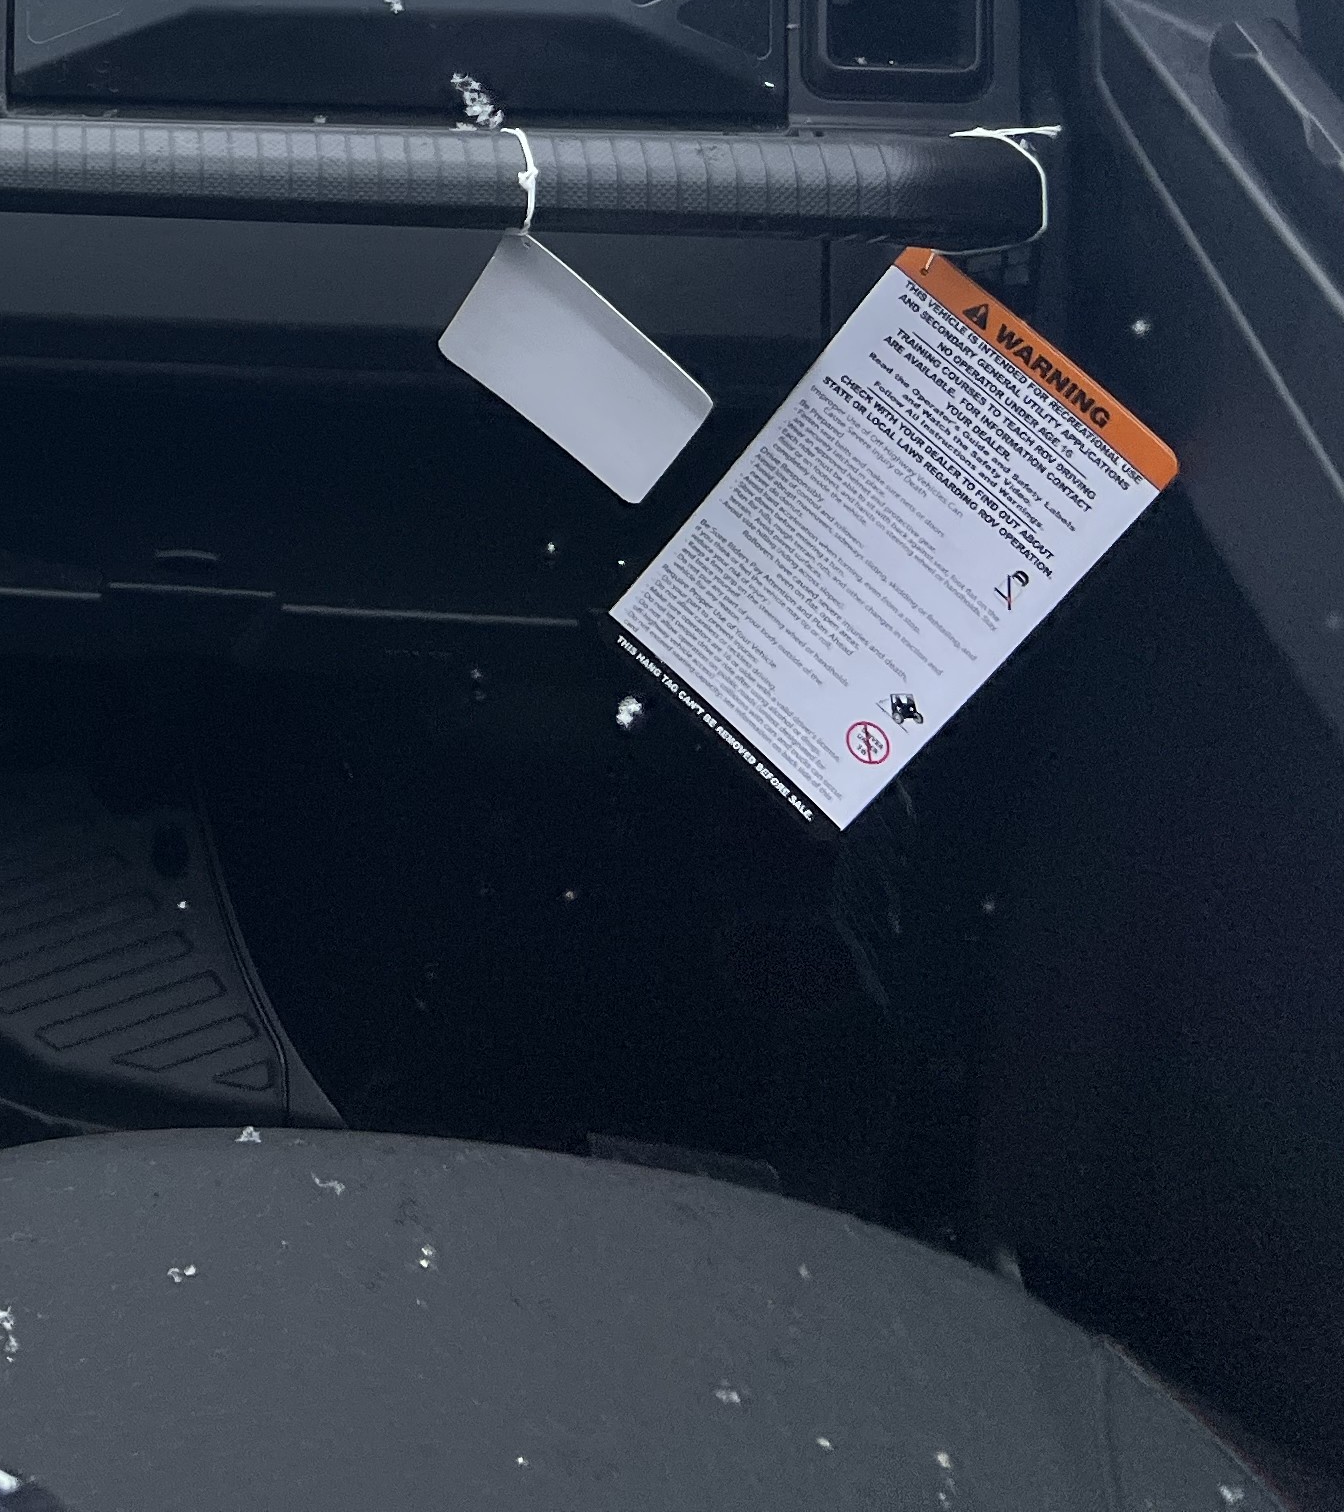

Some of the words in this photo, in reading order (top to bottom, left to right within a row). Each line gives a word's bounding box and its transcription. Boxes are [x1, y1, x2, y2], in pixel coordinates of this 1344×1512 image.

[822, 373, 854, 403] STATE
[850, 397, 868, 416] OR
[864, 410, 898, 441] LOCAL
[894, 436, 925, 465] LAWS
[921, 460, 980, 512] REGARDING
[975, 507, 1000, 530] ROV
[882, 333, 906, 355] ARE
[957, 396, 982, 419] FOR
[978, 414, 1048, 475] INFORMATION
[1044, 470, 1093, 513] CONTACT
[894, 326, 943, 369] TRAINING
[939, 364, 988, 407] COURSES
[986, 403, 1002, 419] TO
[1000, 416, 1036, 447] TEACH
[1033, 443, 1057, 465] ROV
[1054, 461, 1098, 500] DRIVING
[897, 291, 922, 314] AND
[918, 309, 978, 361] SECONDARY
[974, 356, 1022, 398] GENERAL
[1020, 394, 1061, 431] UTILITY
[1059, 427, 1132, 490] APPLICATIONS
[903, 277, 930, 303] THIS
[925, 296, 969, 336] VEHICLE
[965, 330, 981, 346] IS
[976, 339, 1029, 387] INTENDED
[1024, 381, 1050, 404] FOR
[1045, 398, 1122, 465] RECREATIONAL
[1119, 461, 1145, 485] USE
[935, 340, 955, 359] NO
[950, 352, 1006, 401] OPERATOR
[1001, 395, 1040, 430] UNDER
[1036, 424, 1062, 448] AGE
[1058, 443, 1075, 459] 16
[942, 400, 973, 428] YOUR
[991, 322, 1115, 430] WARNING
[839, 372, 874, 404] CHECK
[871, 400, 899, 425] WITH
[895, 420, 926, 448] YOUR
[922, 444, 962, 480] DEALER
[960, 477, 977, 492] TO
[973, 488, 1000, 512] FIND
[997, 508, 1020, 530] OUT
[1019, 527, 1056, 561] ABOUT
[615, 632, 639, 656] THIS
[635, 650, 663, 678] HANG
[658, 672, 680, 694] TAG
[676, 689, 705, 717] CAN'T
[701, 712, 718, 729] BE
[713, 723, 758, 766] REMOVED
[753, 761, 791, 797] BEFORE
